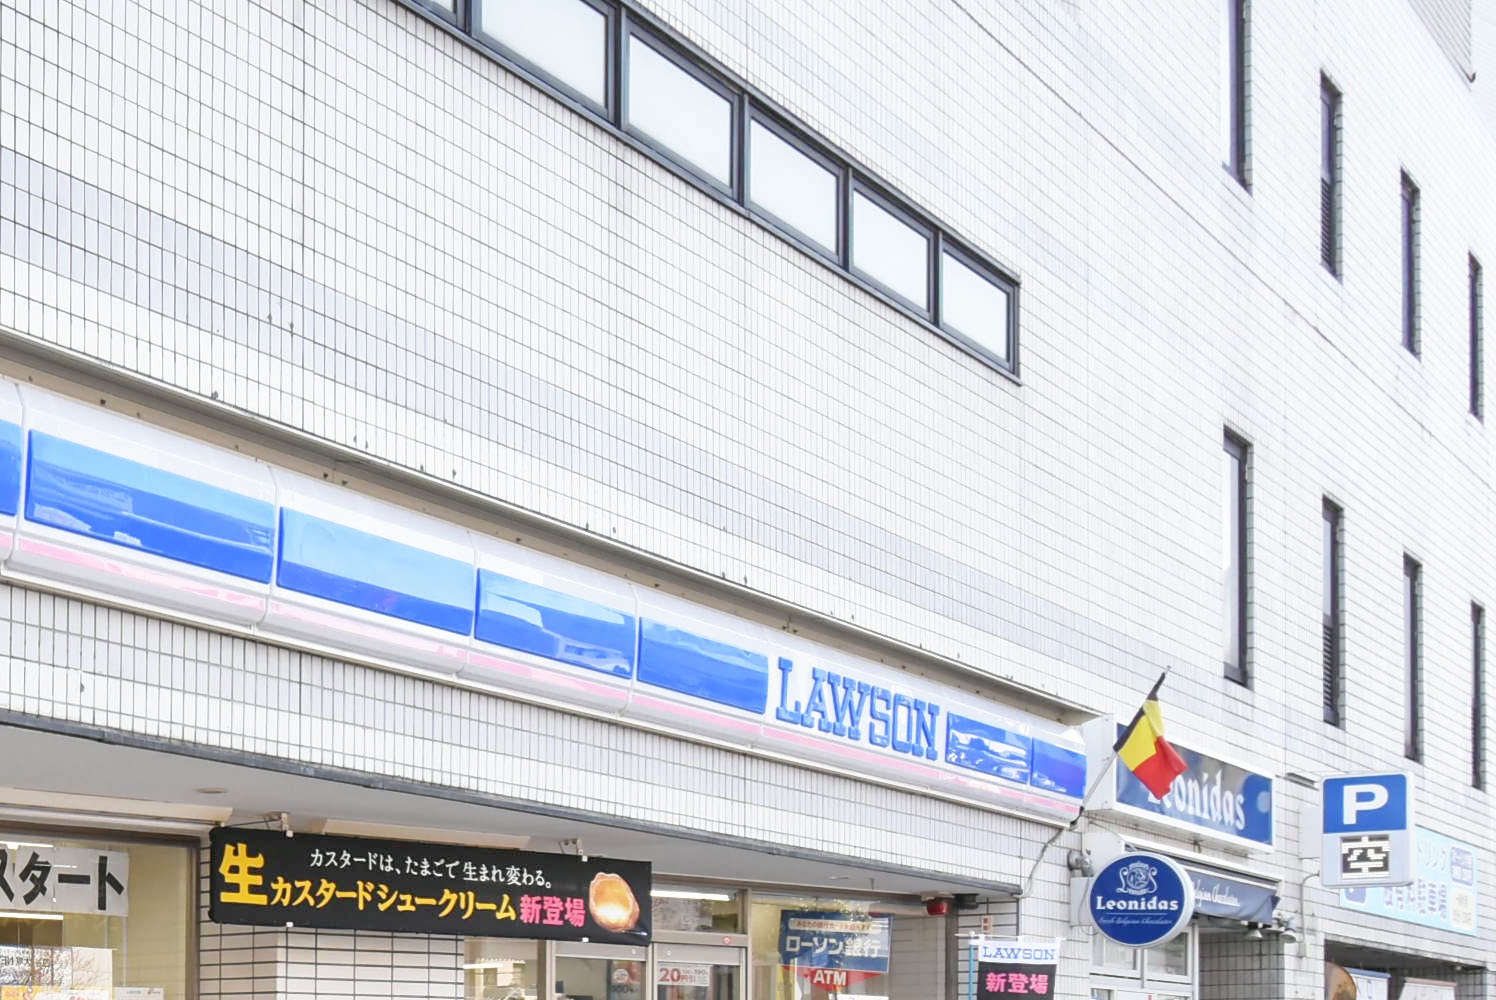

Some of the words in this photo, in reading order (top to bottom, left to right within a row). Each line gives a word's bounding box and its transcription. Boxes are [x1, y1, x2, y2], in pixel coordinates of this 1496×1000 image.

[776, 656, 940, 761] LAWSON
[1148, 770, 1246, 830] onidas
[1343, 783, 1389, 825] P
[218, 842, 269, 907] 生
[1341, 836, 1391, 880] 空
[270, 876, 517, 922] カスタードシュークリーム
[519, 894, 587, 929] 新登場
[1095, 895, 1179, 911] Leonidas
[785, 936, 879, 957] ローソン銀行
[982, 945, 1055, 961] LAWSON
[812, 969, 848, 986] ATM
[984, 971, 1050, 995] 新登場
